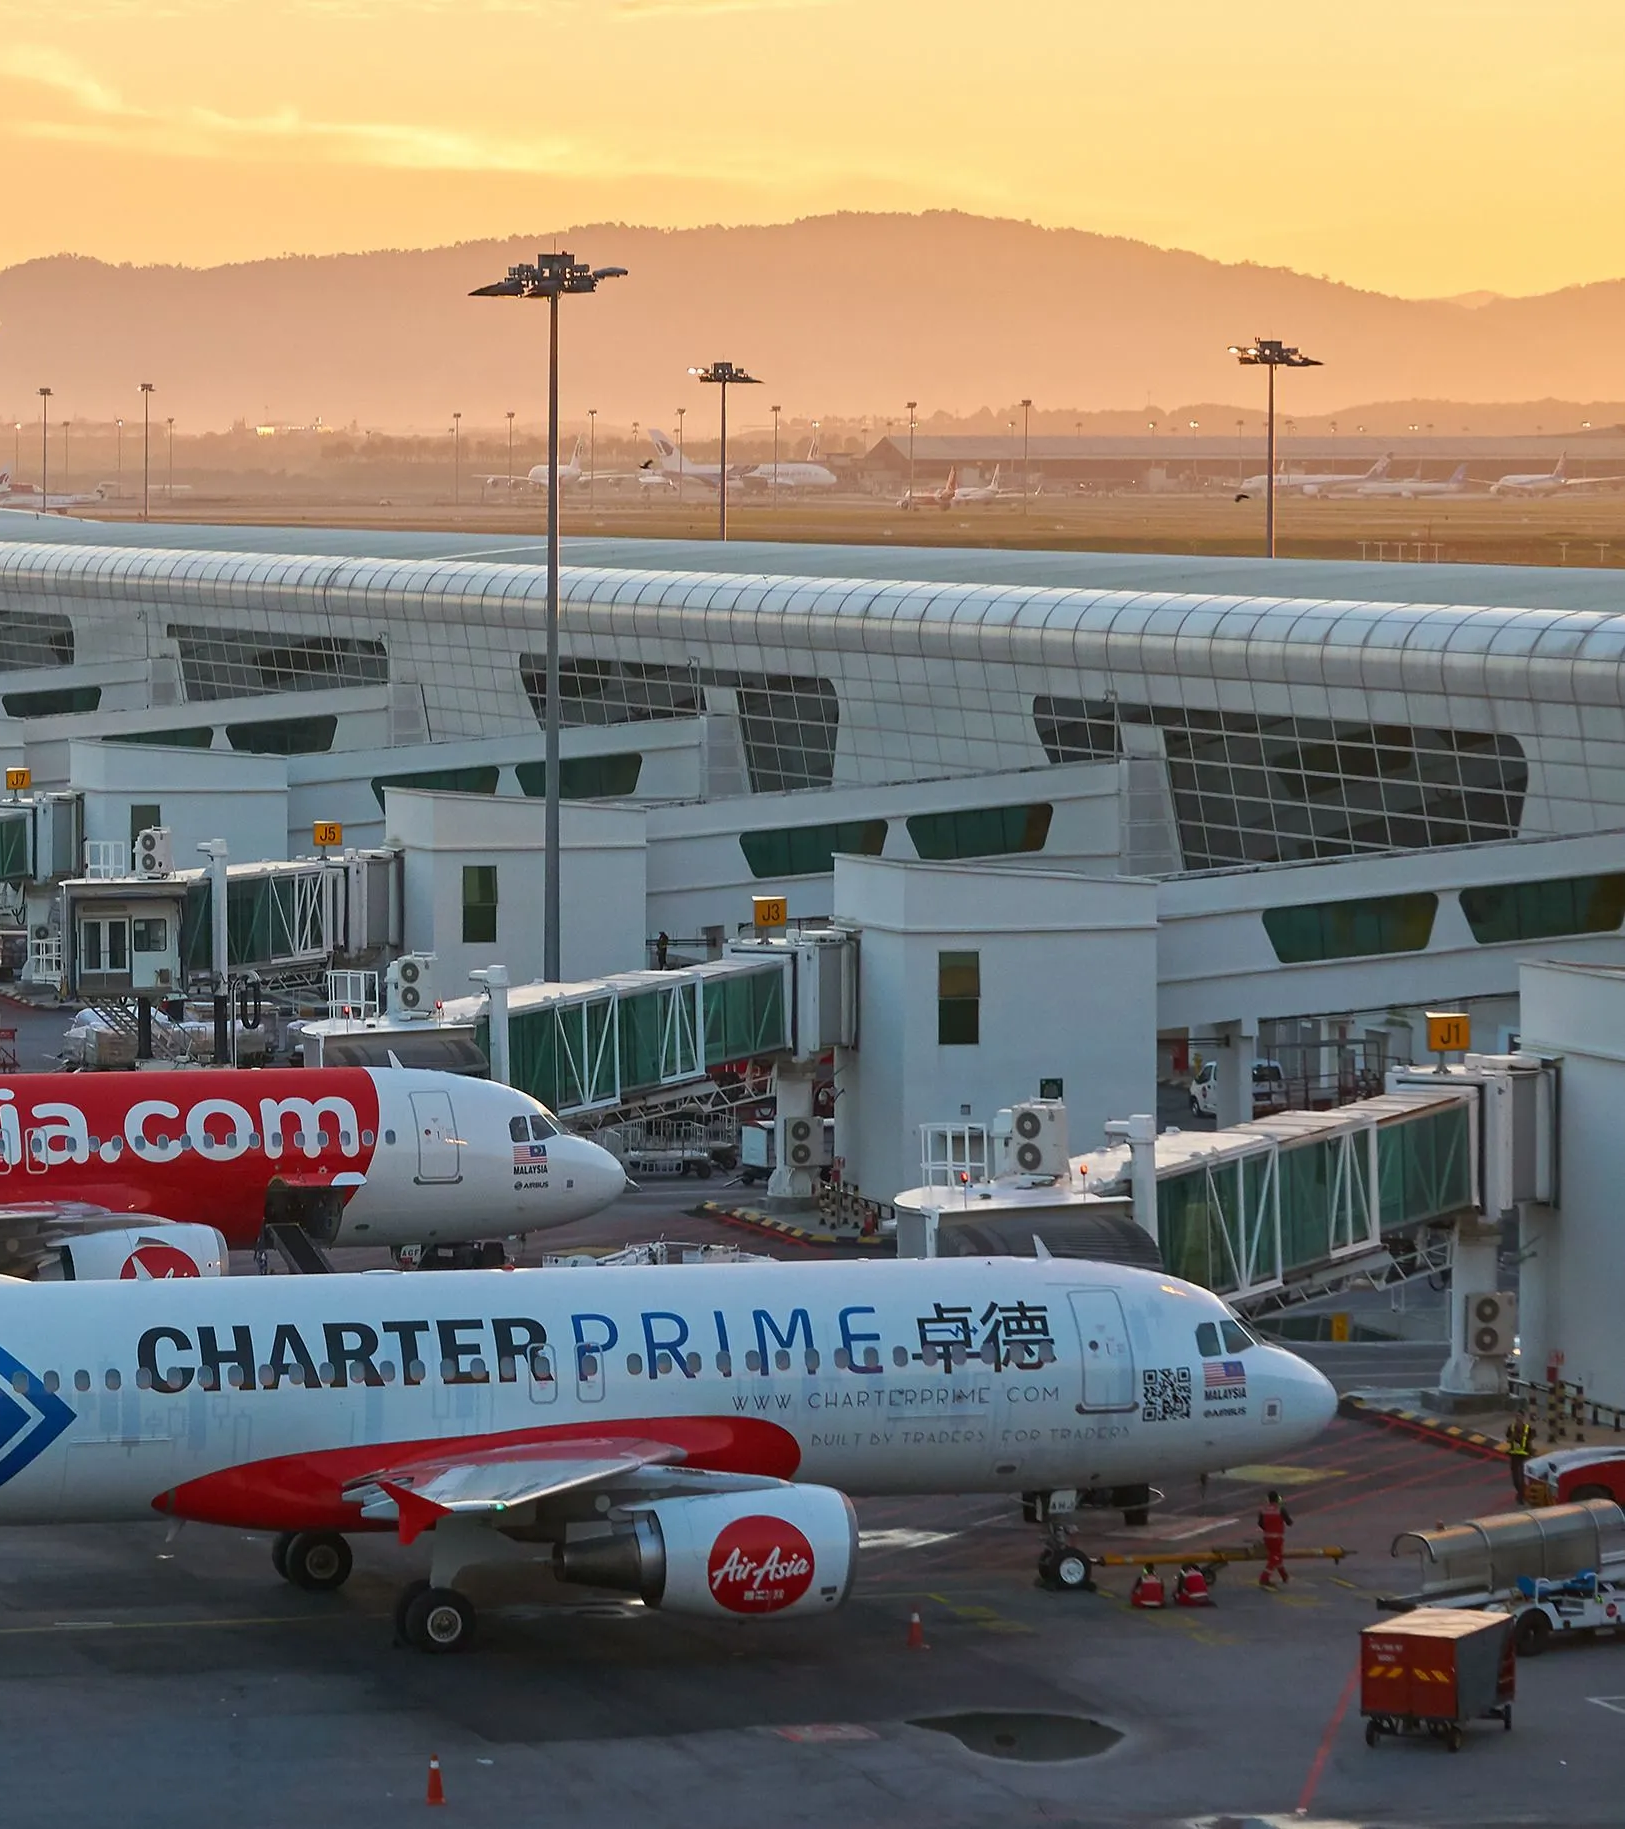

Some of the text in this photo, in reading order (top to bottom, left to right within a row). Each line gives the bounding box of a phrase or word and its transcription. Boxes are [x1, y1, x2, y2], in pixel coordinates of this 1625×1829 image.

[11, 773, 25, 786] J7
[319, 826, 336, 842] J5
[762, 903, 780, 921] J3
[1440, 1023, 1460, 1045] J1
[513, 1164, 549, 1176] MALAYSIA
[912, 1300, 1056, 1375] 卓德
[137, 1305, 885, 1394] CHARTER PRIME
[1203, 1387, 1248, 1402] MALAYSIA
